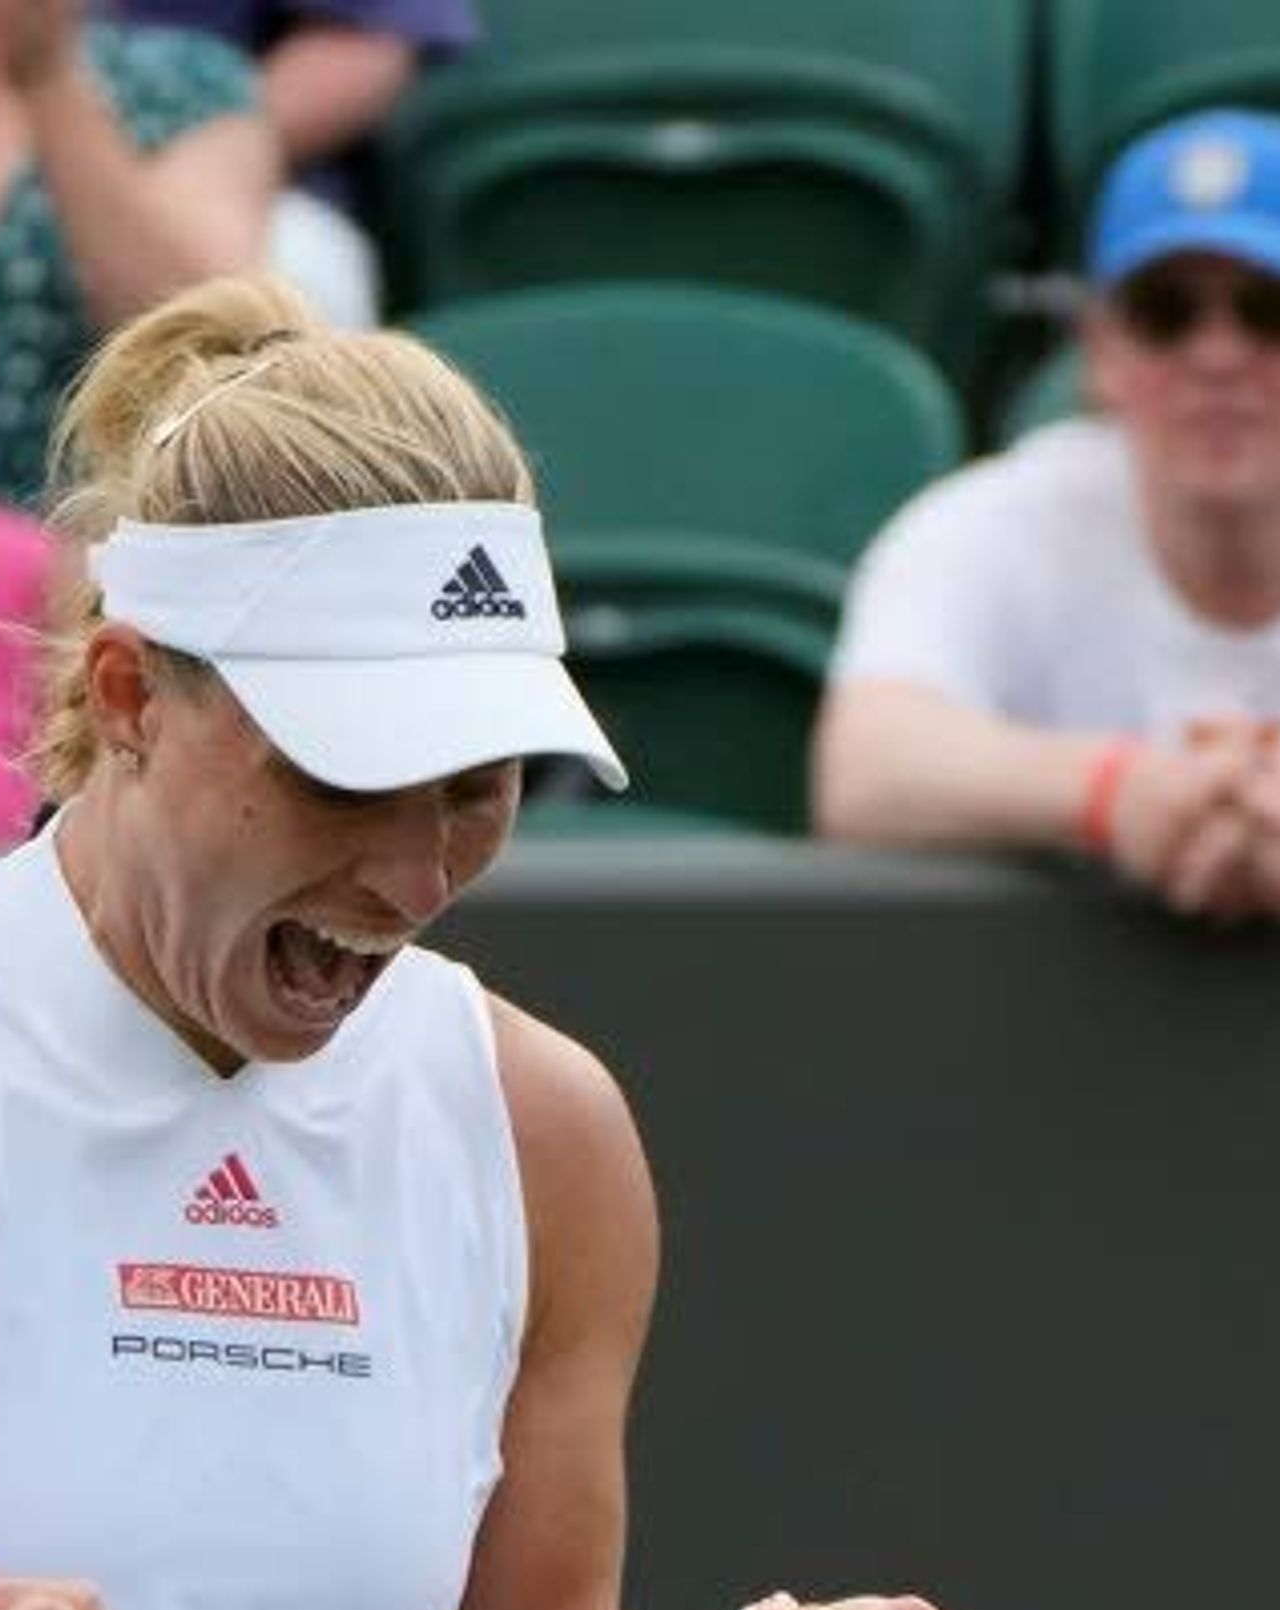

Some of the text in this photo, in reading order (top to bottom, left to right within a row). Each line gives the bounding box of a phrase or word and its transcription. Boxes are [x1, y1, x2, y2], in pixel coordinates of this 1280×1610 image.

[431, 592, 526, 621] adidas
[184, 1200, 279, 1229] adidas
[180, 1271, 354, 1319] GENERALI
[112, 1335, 372, 1377] PORSCHE
